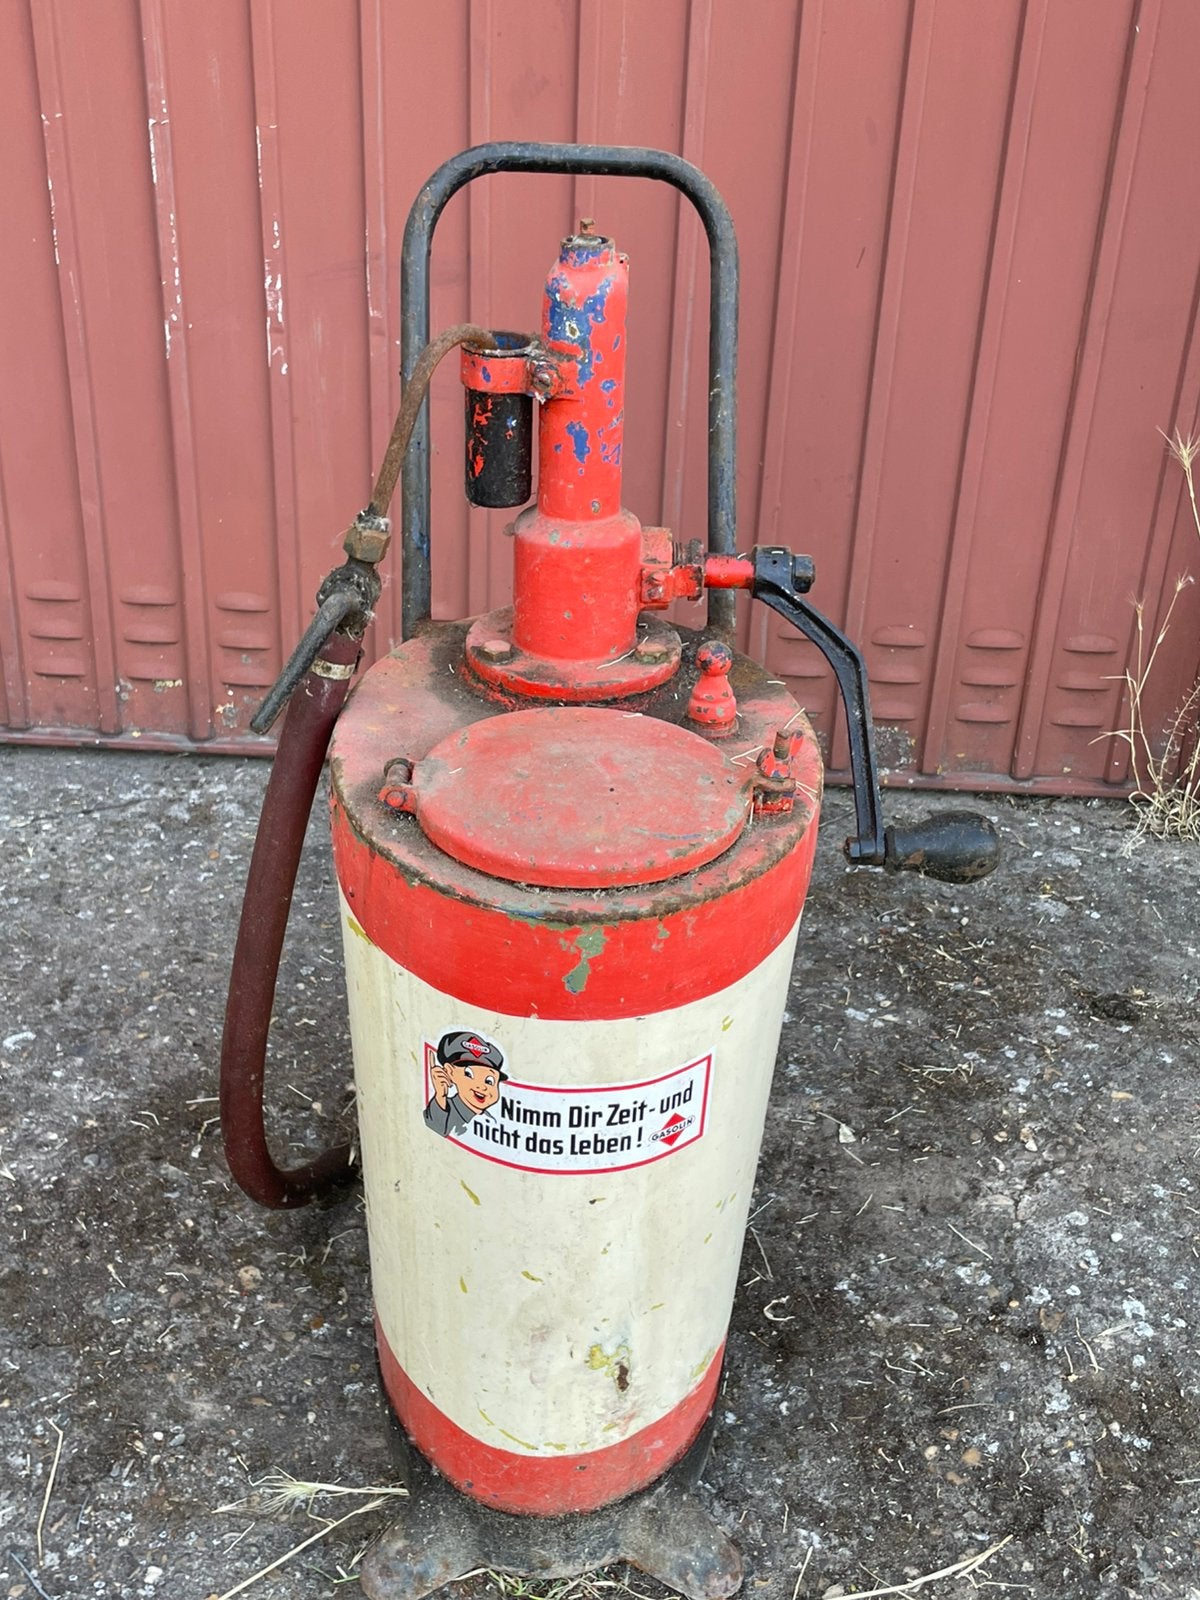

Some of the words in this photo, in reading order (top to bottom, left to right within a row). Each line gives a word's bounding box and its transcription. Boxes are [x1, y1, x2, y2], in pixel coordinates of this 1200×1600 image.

[501, 1096, 561, 1128] Nimm
[568, 1105, 602, 1128] Dir
[660, 1079, 693, 1114] und
[473, 1119, 520, 1149] nicht
[525, 1132, 563, 1155] das
[651, 1117, 693, 1141] GASOLIN
